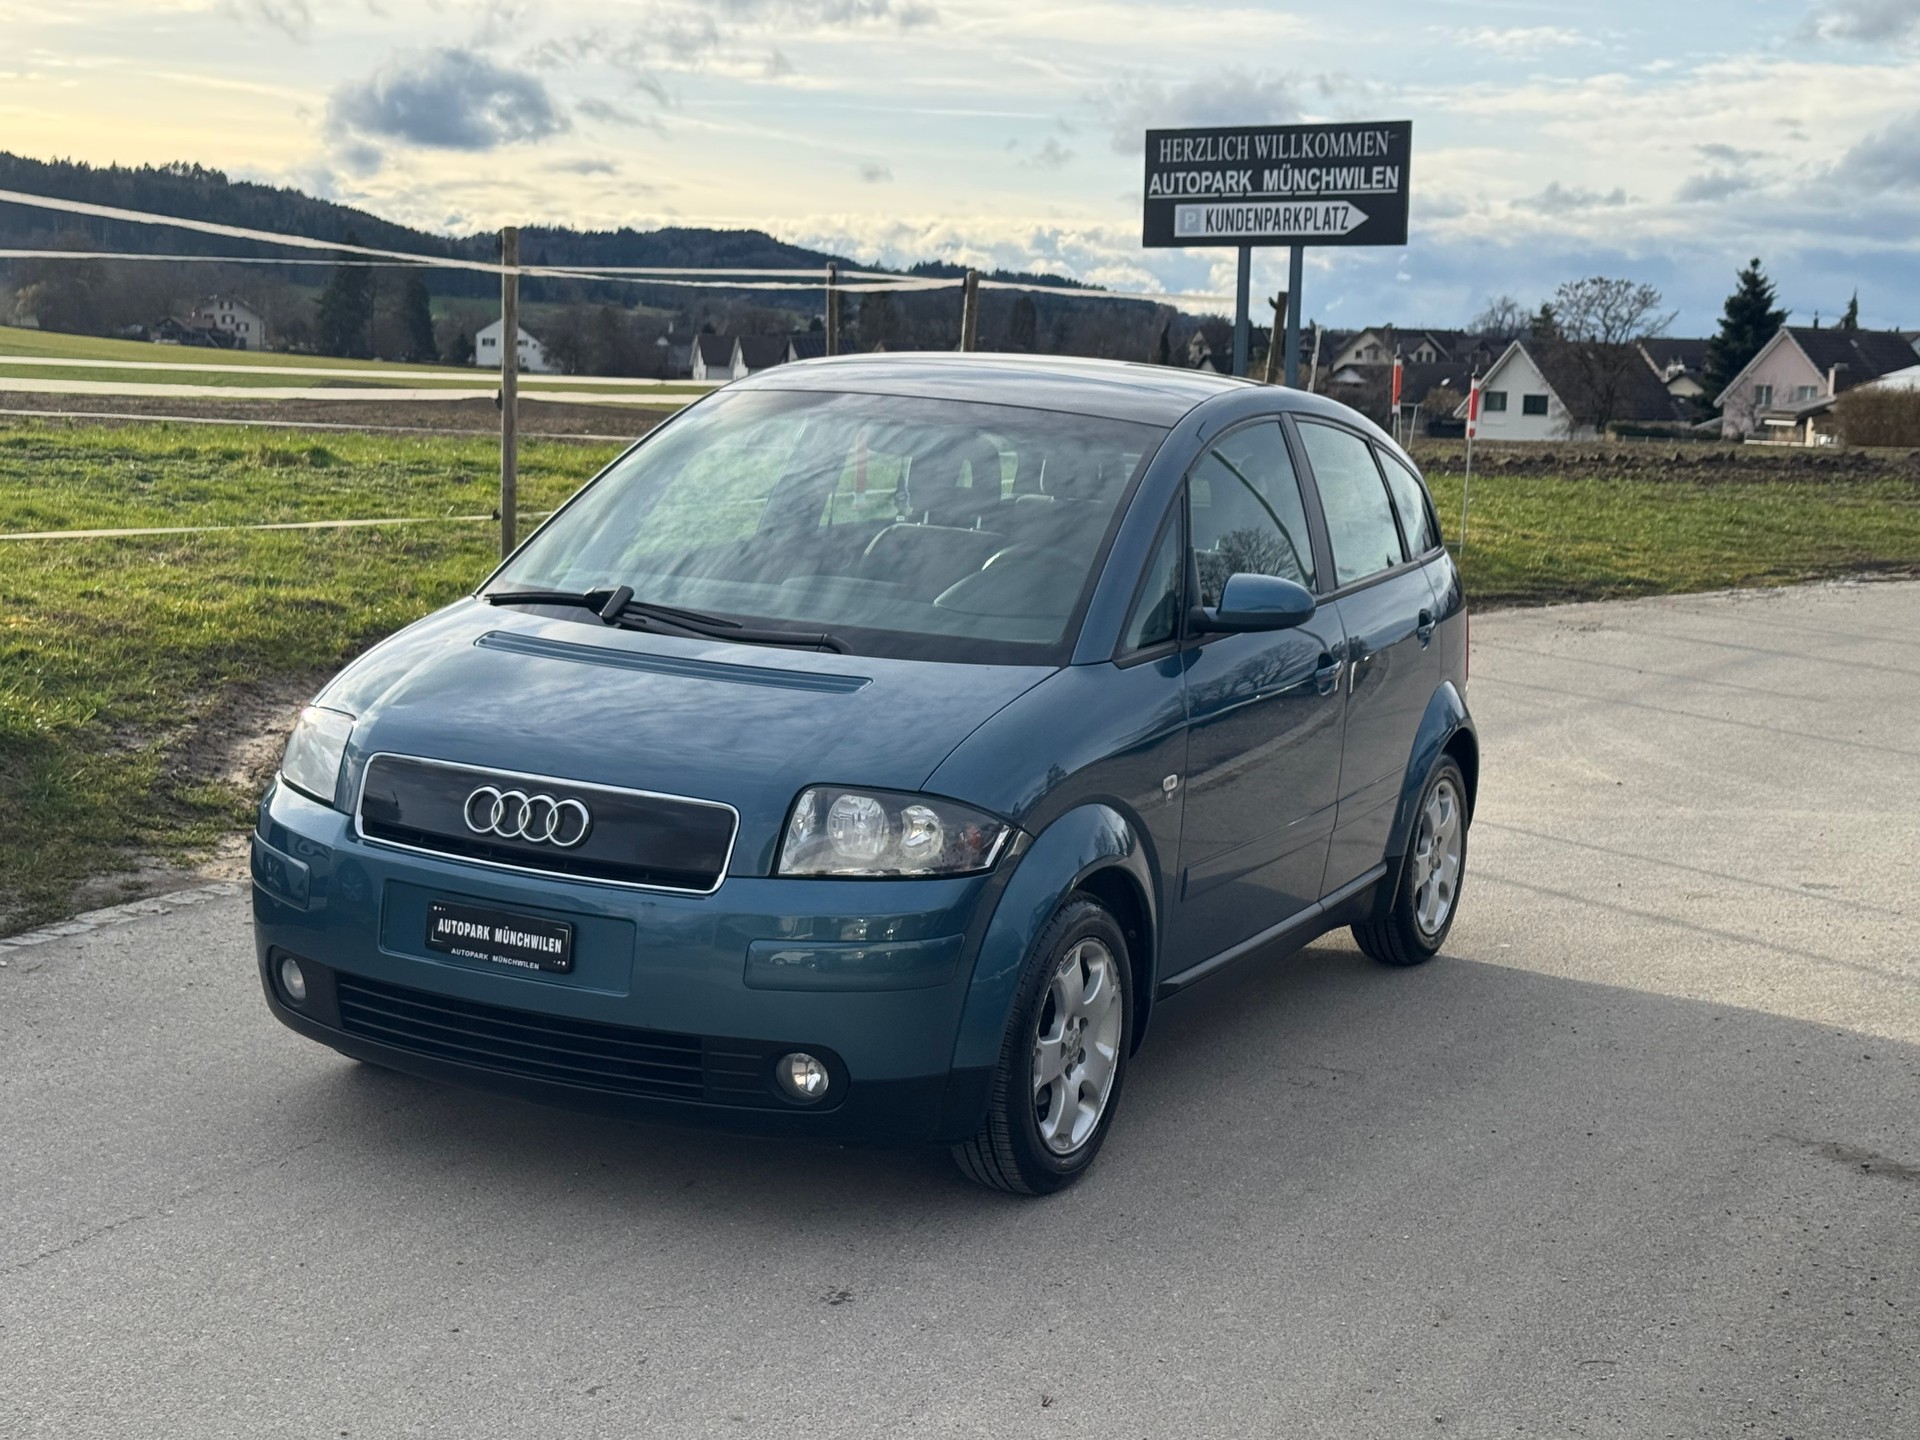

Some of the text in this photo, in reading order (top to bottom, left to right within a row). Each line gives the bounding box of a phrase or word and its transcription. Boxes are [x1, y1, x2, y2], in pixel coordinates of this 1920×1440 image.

[1159, 130, 1390, 163] HERZLICH WILLKOMMEN
[1149, 164, 1399, 194] AUTOPARK MÜNCHWILEN
[1183, 206, 1350, 233] P KUNDENPARKPLATZ
[437, 918, 562, 953] AUTOPARK MÜNCHWILEN
[451, 948, 540, 970] AUTOPARK MÜNCHWILEN
